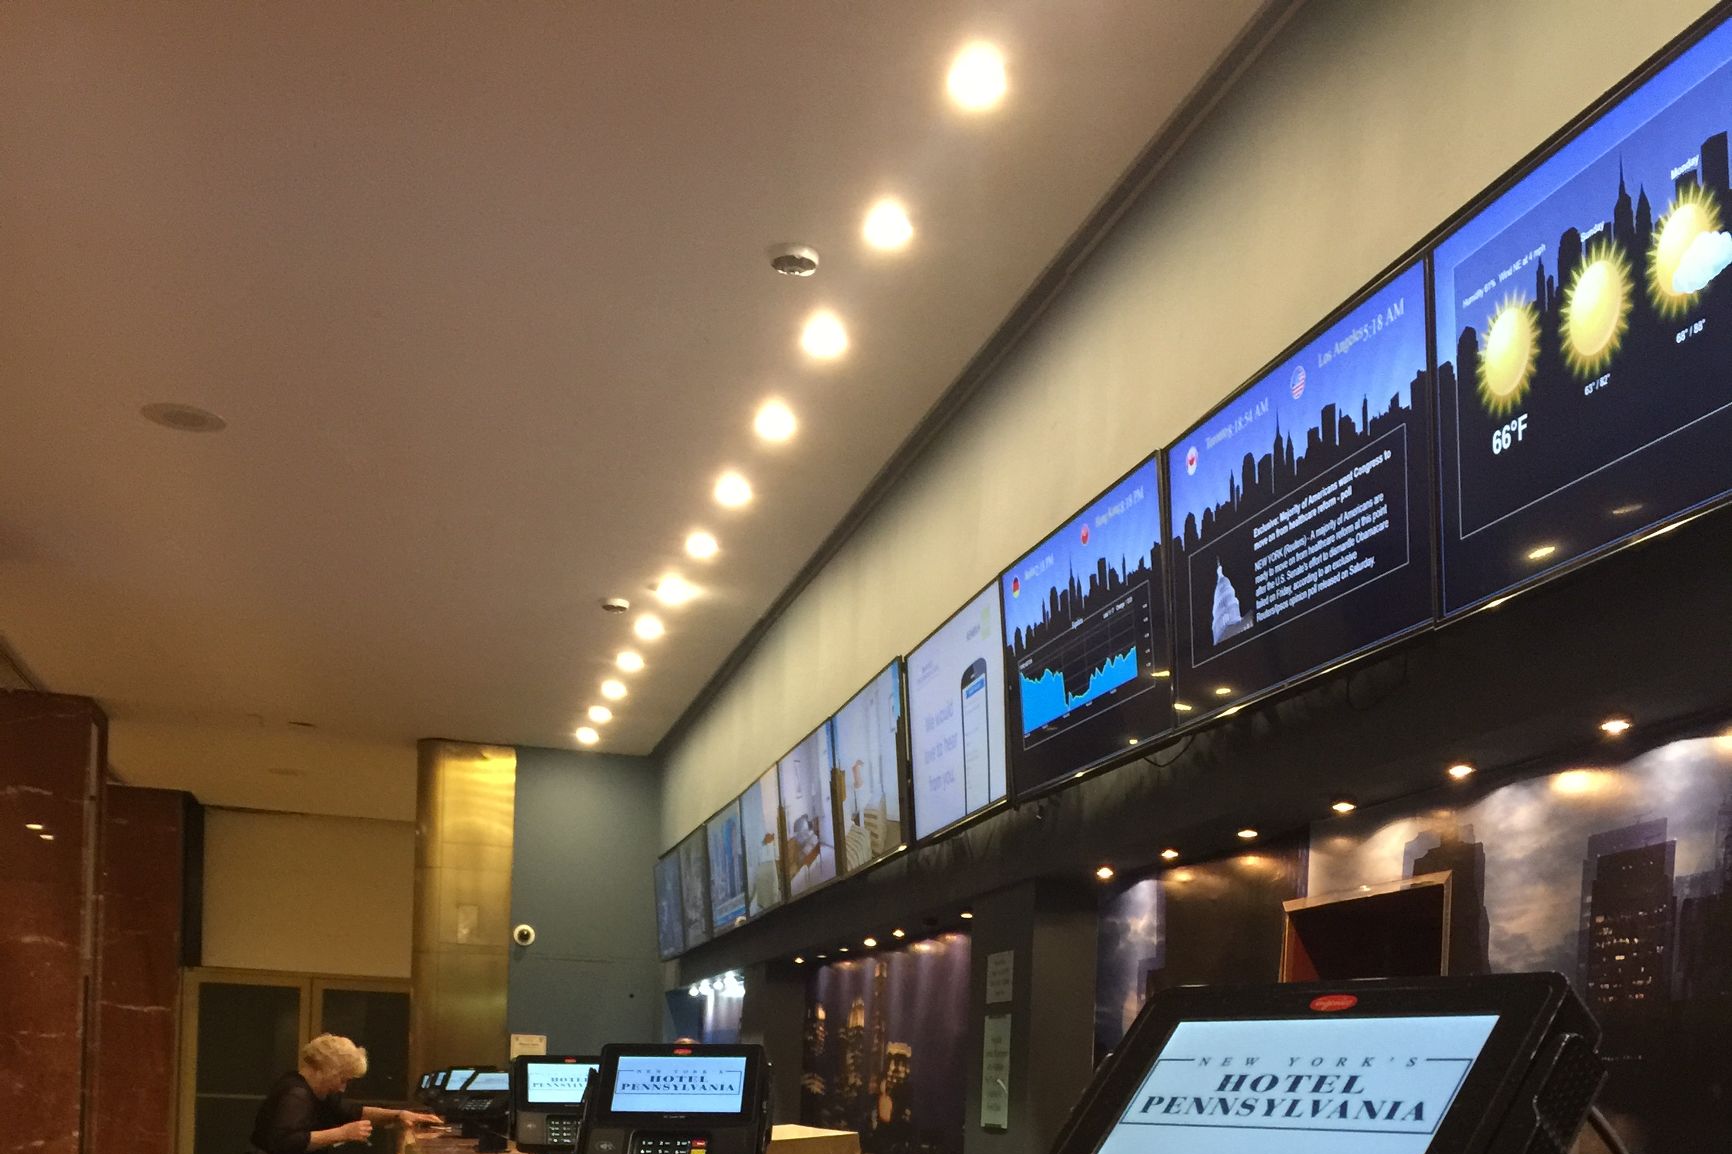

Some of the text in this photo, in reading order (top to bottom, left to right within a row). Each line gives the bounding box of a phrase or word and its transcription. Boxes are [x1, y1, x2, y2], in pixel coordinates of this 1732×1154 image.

[1385, 297, 1404, 327] AM
[1492, 413, 1528, 455] 66°F
[1254, 557, 1267, 571] NEW
[1198, 1057, 1419, 1068] NEW YORK'S
[621, 1083, 734, 1091] PENNSYLVANIA
[650, 1075, 708, 1083] HOTEL
[1215, 1073, 1365, 1094] HOTEL
[1138, 1095, 1426, 1122] PENNSYLVANIA
